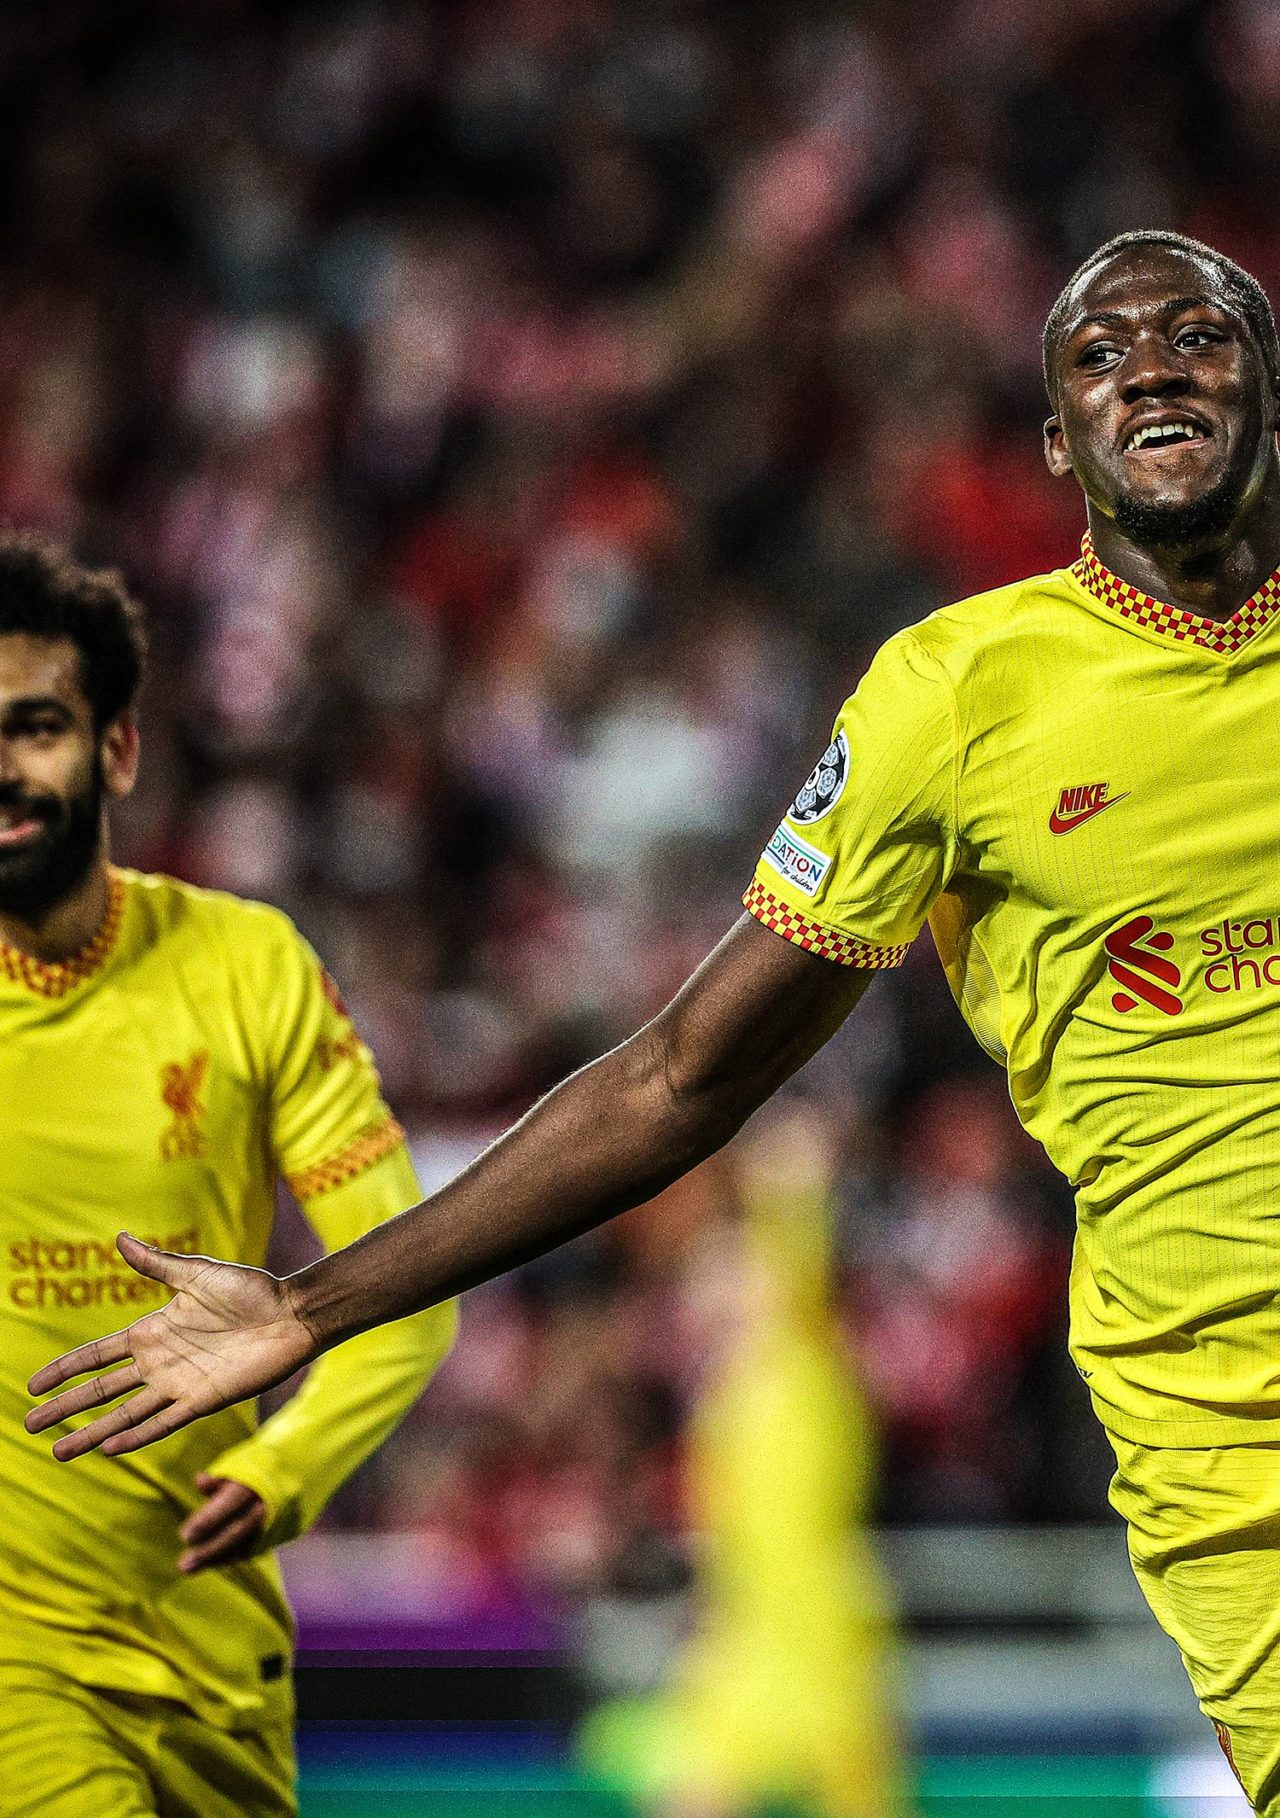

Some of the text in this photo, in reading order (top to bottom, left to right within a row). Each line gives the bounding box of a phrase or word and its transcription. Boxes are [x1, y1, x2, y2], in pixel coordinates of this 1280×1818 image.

[1058, 782, 1108, 814] NIKE
[769, 833, 822, 882] DATION
[790, 874, 814, 892] children
